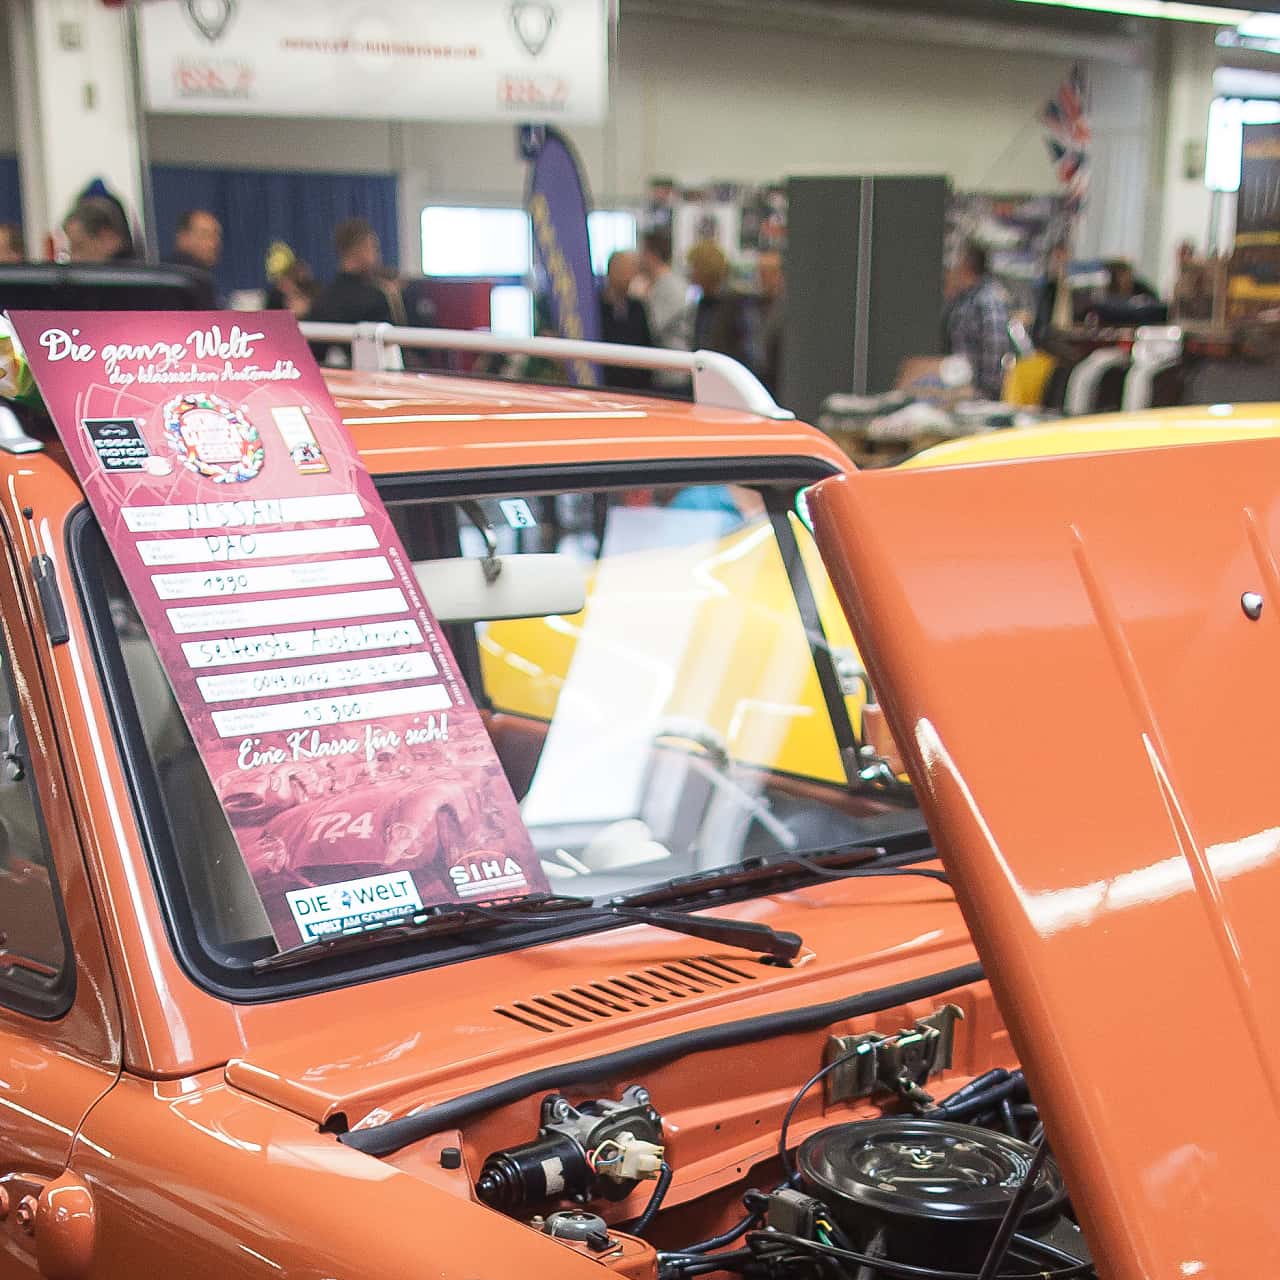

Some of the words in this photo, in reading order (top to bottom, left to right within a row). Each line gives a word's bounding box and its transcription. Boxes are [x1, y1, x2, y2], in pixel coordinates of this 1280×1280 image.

[39, 328, 96, 361] Die
[101, 341, 187, 373] ganze
[186, 325, 265, 359] Welt
[186, 499, 284, 529] NISSAN
[204, 574, 249, 594] 1990
[237, 738, 286, 770] Eine
[286, 729, 360, 761] Klasse
[363, 723, 401, 761] für
[405, 713, 450, 745] sich!
[449, 857, 522, 885] SIHA
[295, 895, 331, 916] DIE
[309, 919, 342, 935] WELT
